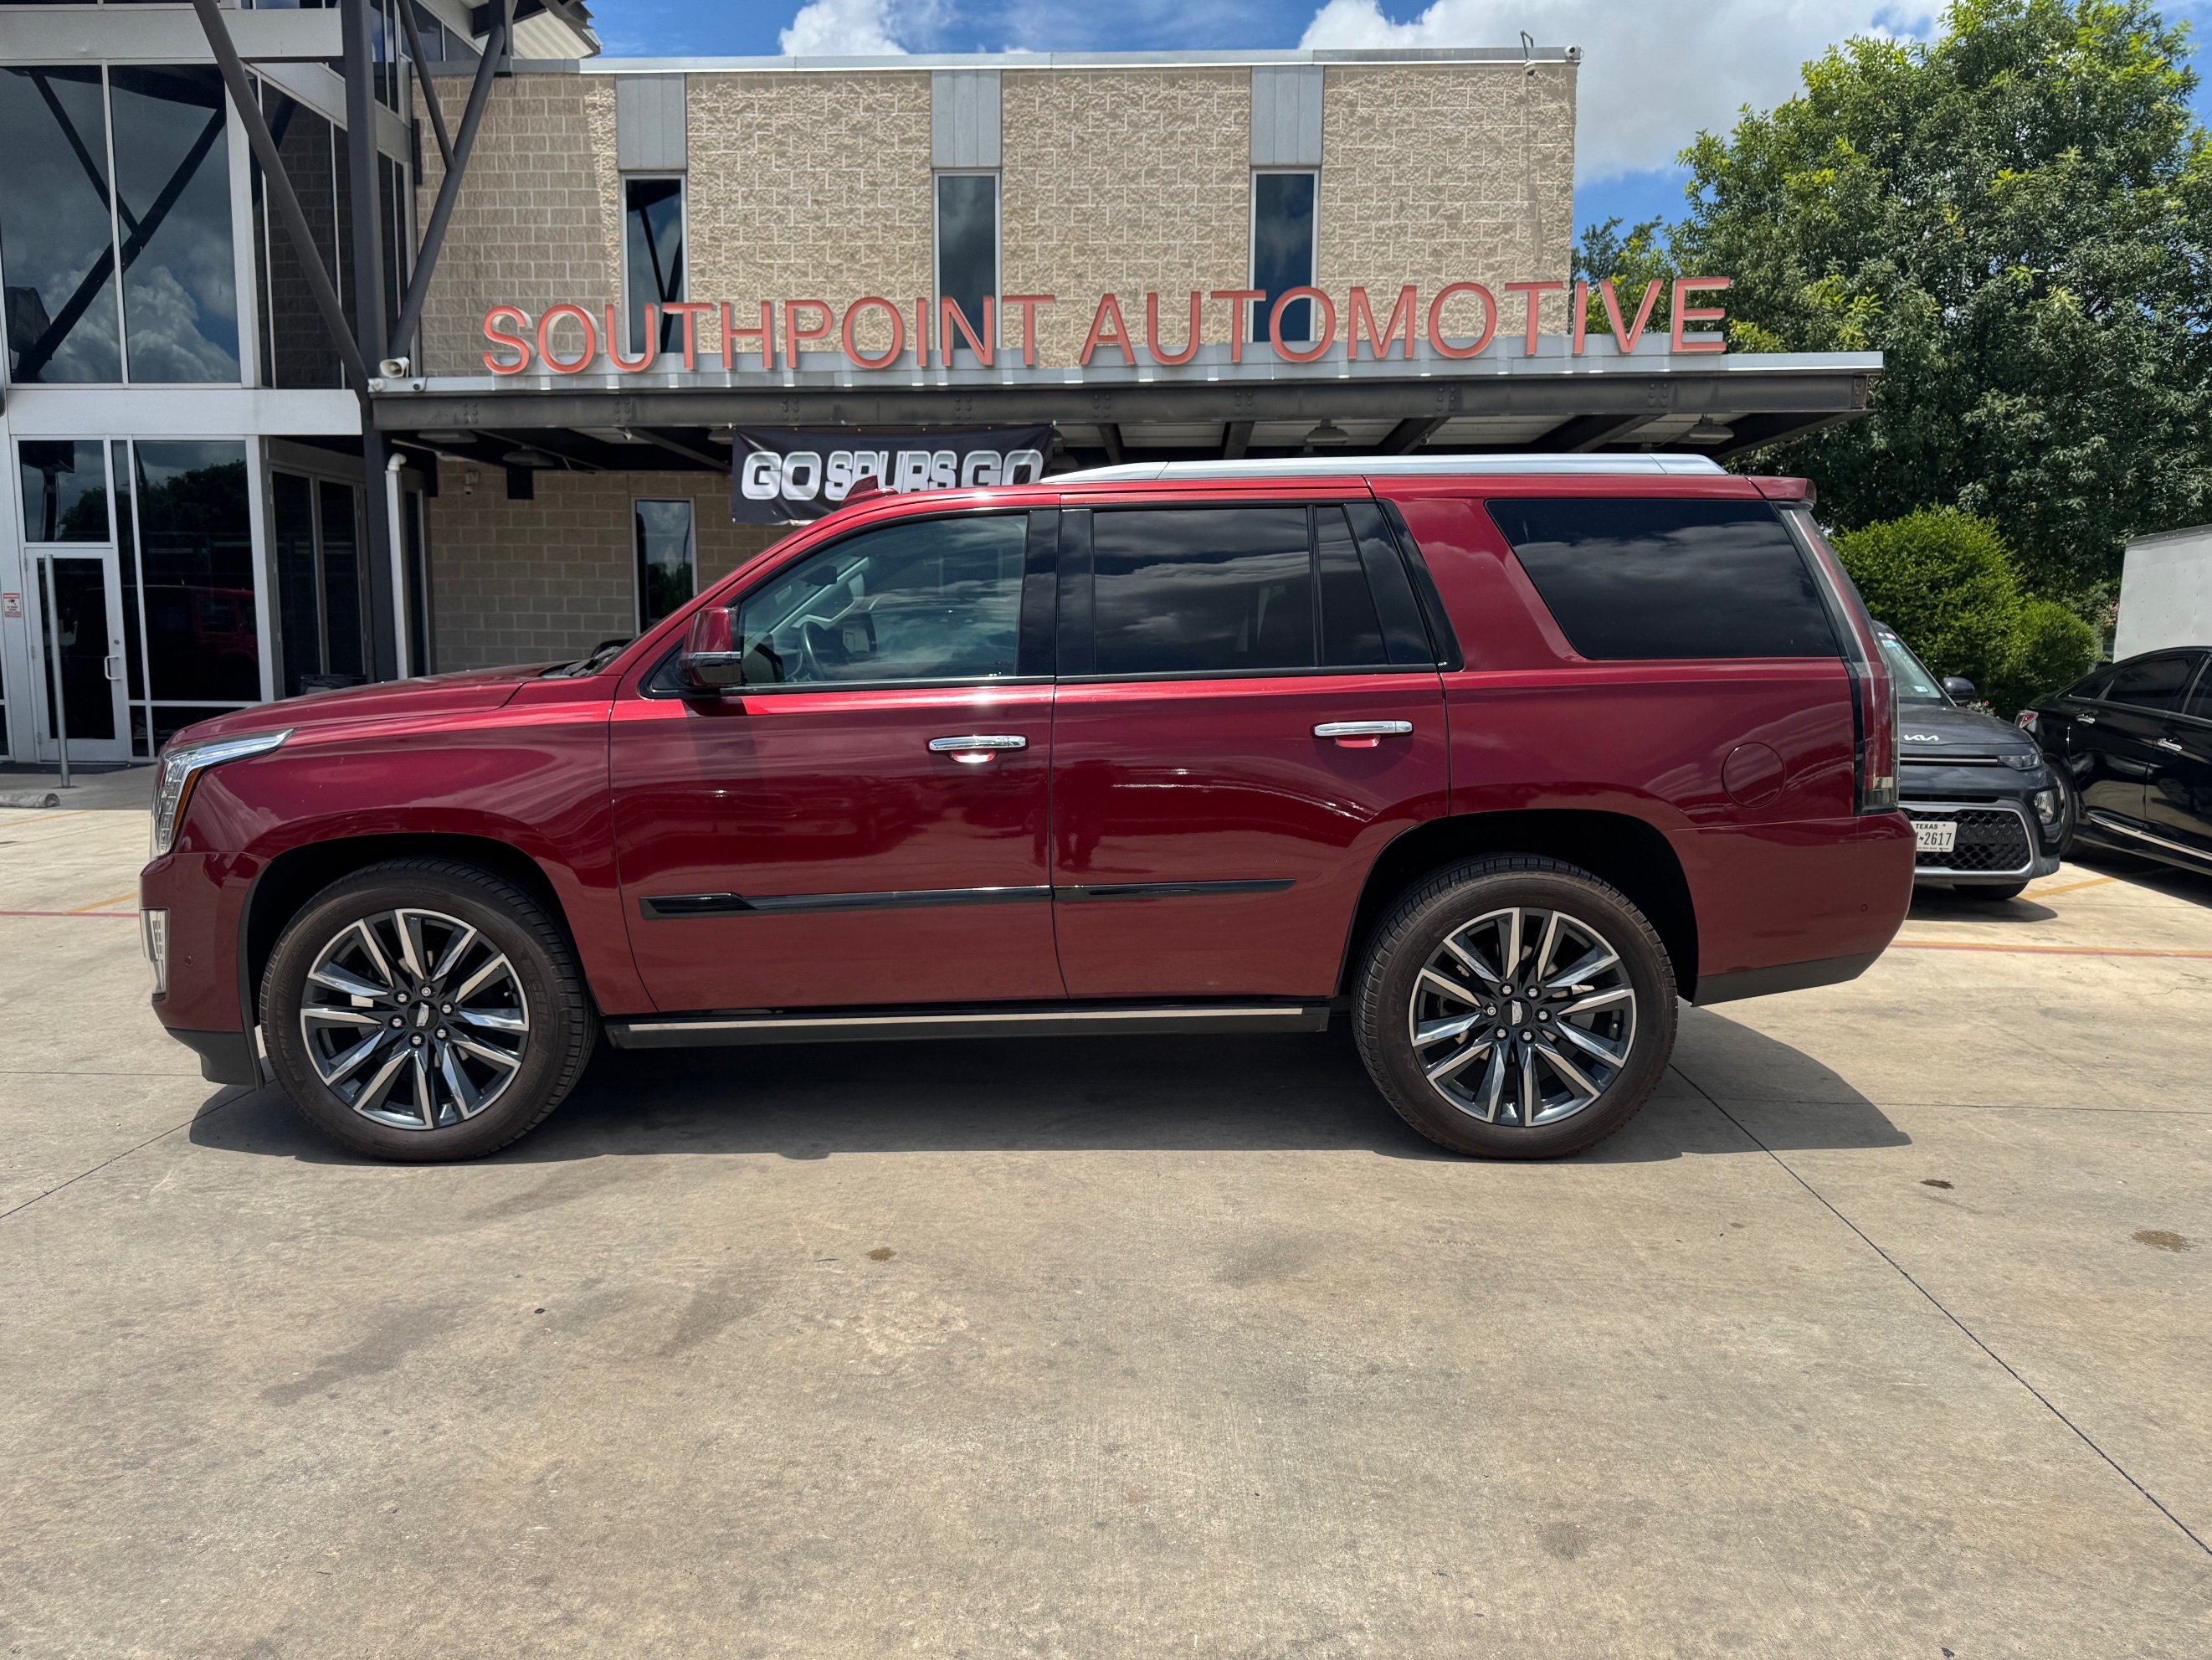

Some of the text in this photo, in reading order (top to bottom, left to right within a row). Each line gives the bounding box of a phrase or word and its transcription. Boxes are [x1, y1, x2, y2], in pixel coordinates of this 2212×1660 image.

[482, 275, 1731, 375] SOUTHPOINT AUTOMOTIVE
[741, 449, 1044, 501] GO SPURS GO
